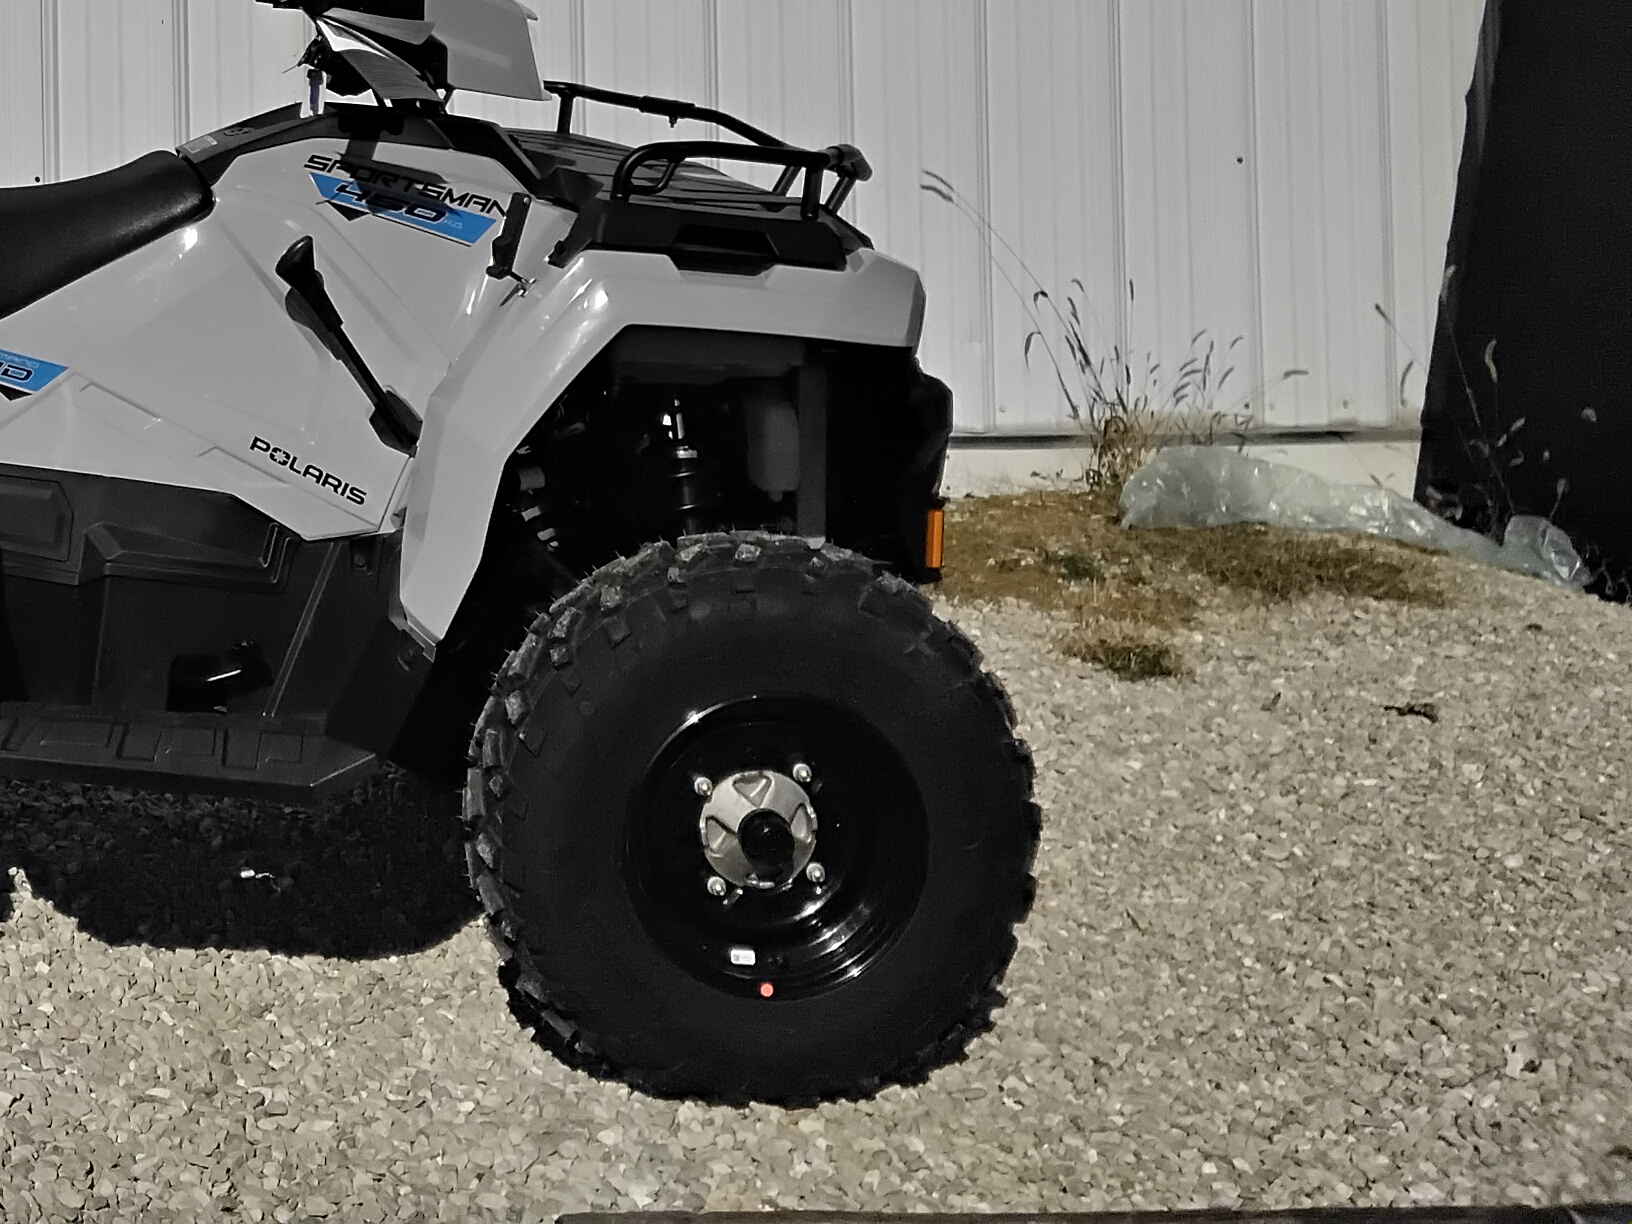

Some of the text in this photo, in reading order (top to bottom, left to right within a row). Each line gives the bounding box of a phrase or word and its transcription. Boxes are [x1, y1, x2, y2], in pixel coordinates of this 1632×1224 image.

[303, 154, 507, 217] SPORTSMAN
[334, 182, 447, 224] 450
[249, 435, 367, 505] POLARIS
